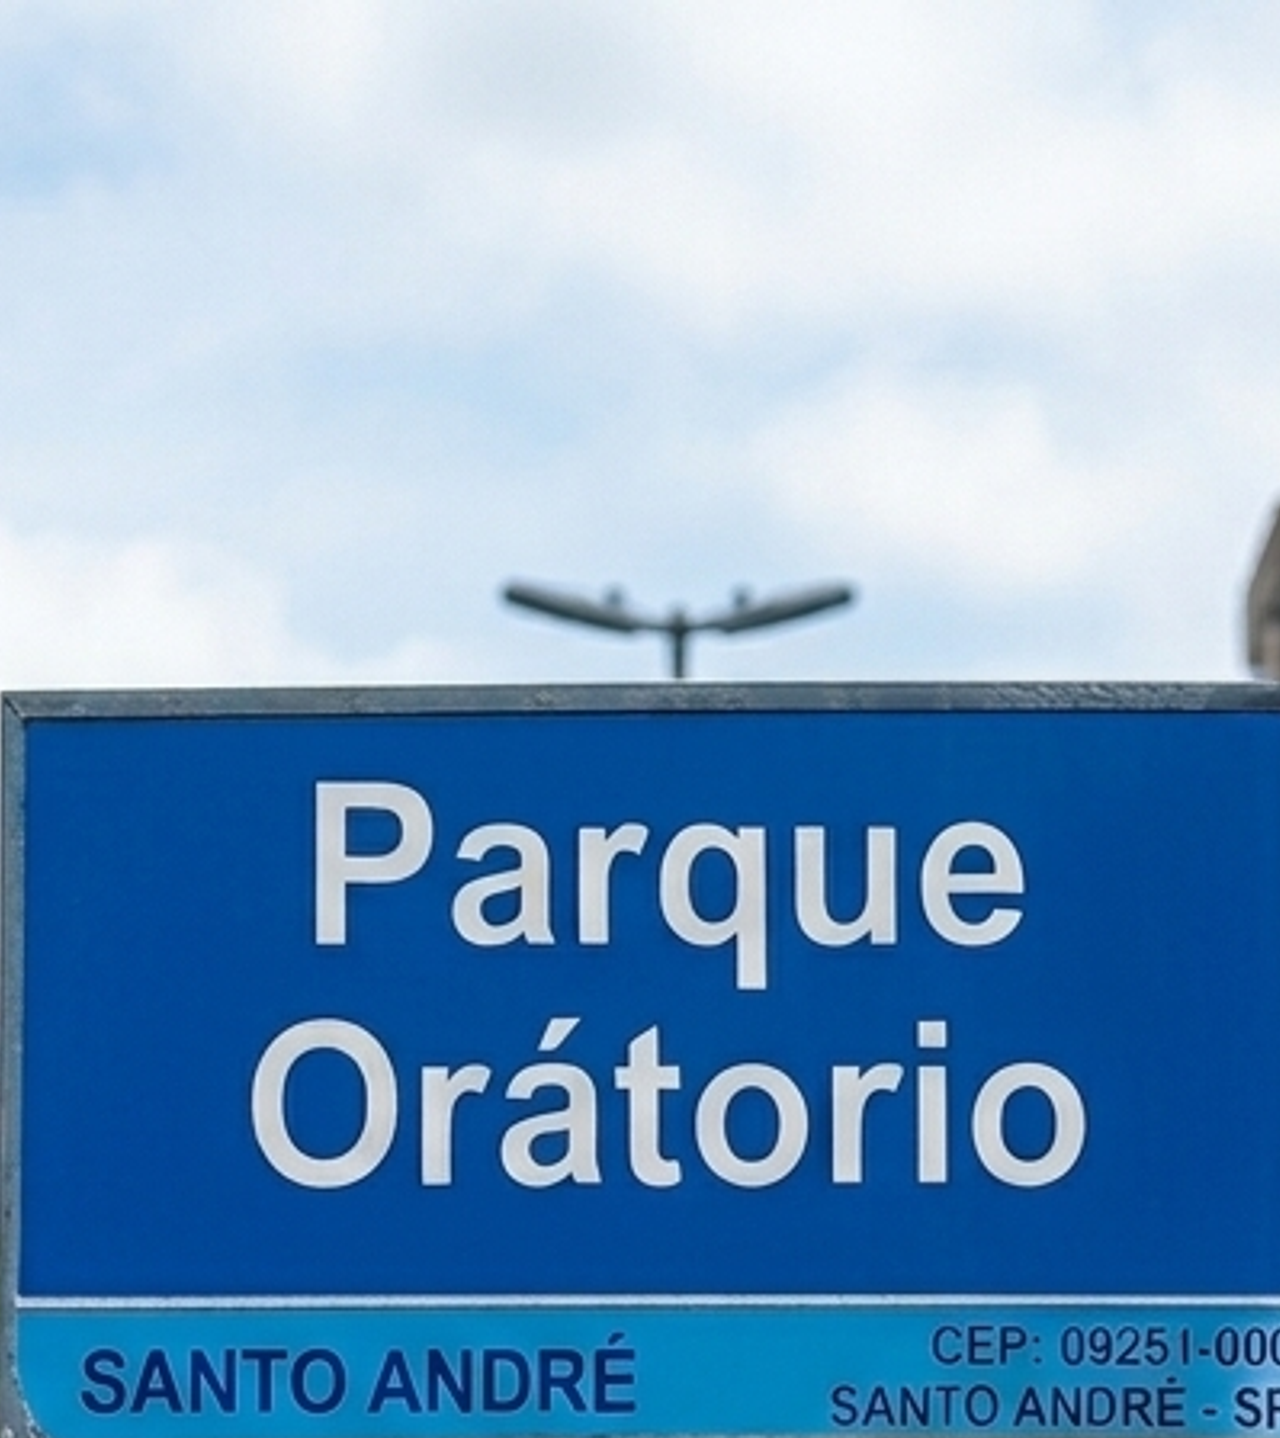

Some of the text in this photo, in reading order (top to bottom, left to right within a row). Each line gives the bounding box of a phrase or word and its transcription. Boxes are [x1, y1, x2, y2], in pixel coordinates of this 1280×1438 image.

[315, 781, 1025, 991] Parque
[251, 1017, 1086, 1189] Orátorio
[80, 1331, 637, 1415] SANTO ANDRÉ
[931, 1324, 1043, 1367] CEP:
[830, 1384, 1000, 1428] SANTO
